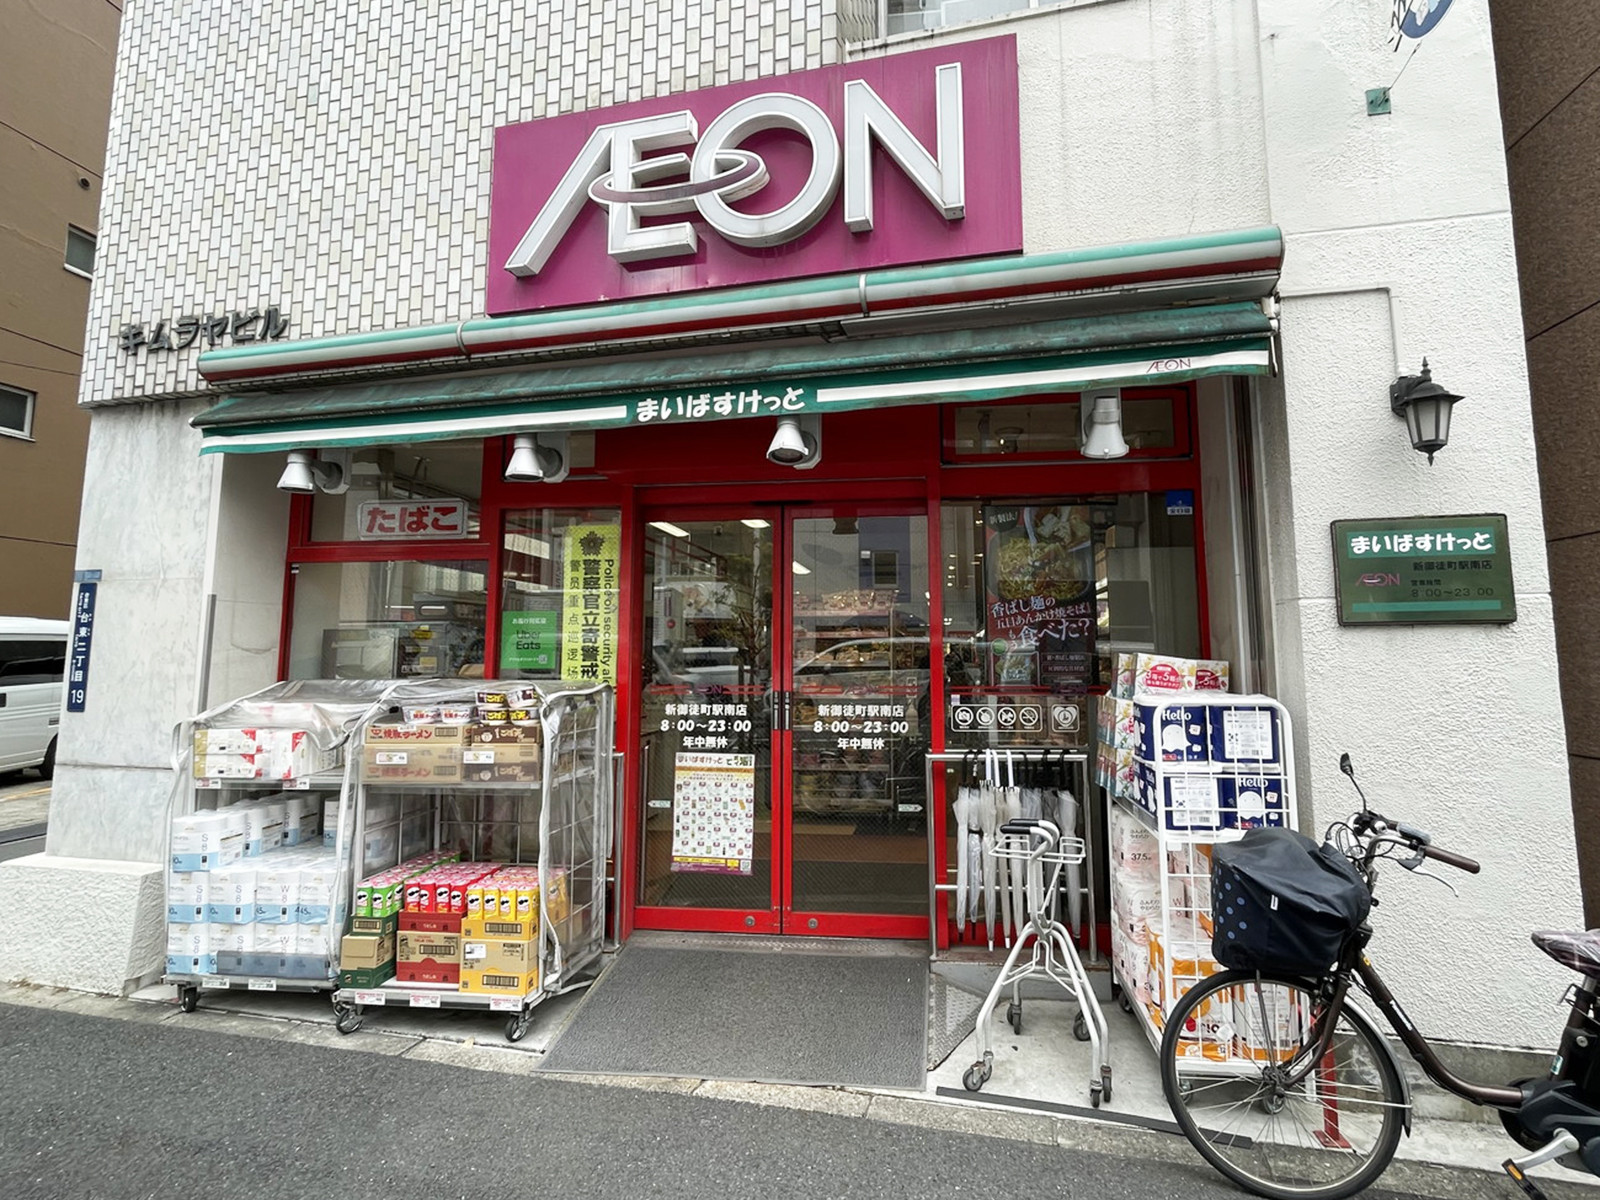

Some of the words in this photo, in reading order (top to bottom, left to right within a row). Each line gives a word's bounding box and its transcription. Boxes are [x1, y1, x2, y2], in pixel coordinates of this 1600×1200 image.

[120, 307, 288, 354] キムラヤビル
[636, 386, 806, 422] まいばすけっと
[366, 505, 458, 533] たばこ
[1350, 532, 1493, 555] まいばすけっと
[1412, 560, 1493, 572] 新御徒町駅南店
[603, 559, 615, 597] Police
[603, 599, 614, 614] on
[516, 629, 541, 639] Uber
[600, 616, 614, 667] security
[74, 611, 89, 682] 台東二丁目
[516, 640, 541, 650] Eats
[70, 689, 85, 704] 19
[664, 703, 748, 717] 新御徒町駅南店
[817, 704, 905, 717] 新御徒町駅南店
[1162, 709, 1192, 721] Helo
[682, 736, 729, 748] 年中無休
[837, 737, 885, 750] 年中無休
